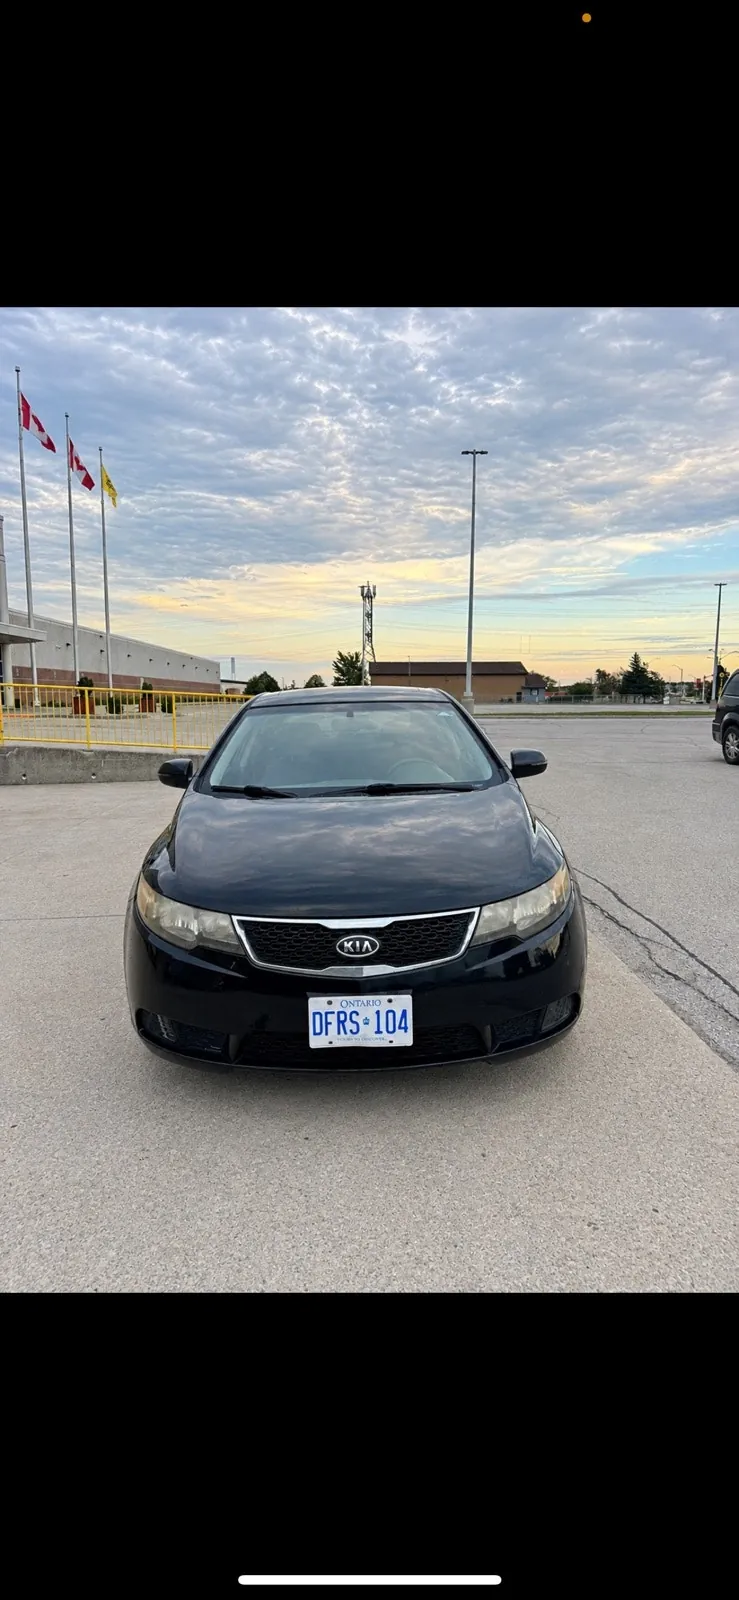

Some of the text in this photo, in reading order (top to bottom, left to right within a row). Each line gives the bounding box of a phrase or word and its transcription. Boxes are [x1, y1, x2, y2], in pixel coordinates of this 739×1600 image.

[343, 940, 373, 953] KIA
[340, 999, 382, 1009] ONTARIO
[312, 1009, 409, 1036] DFRS 104
